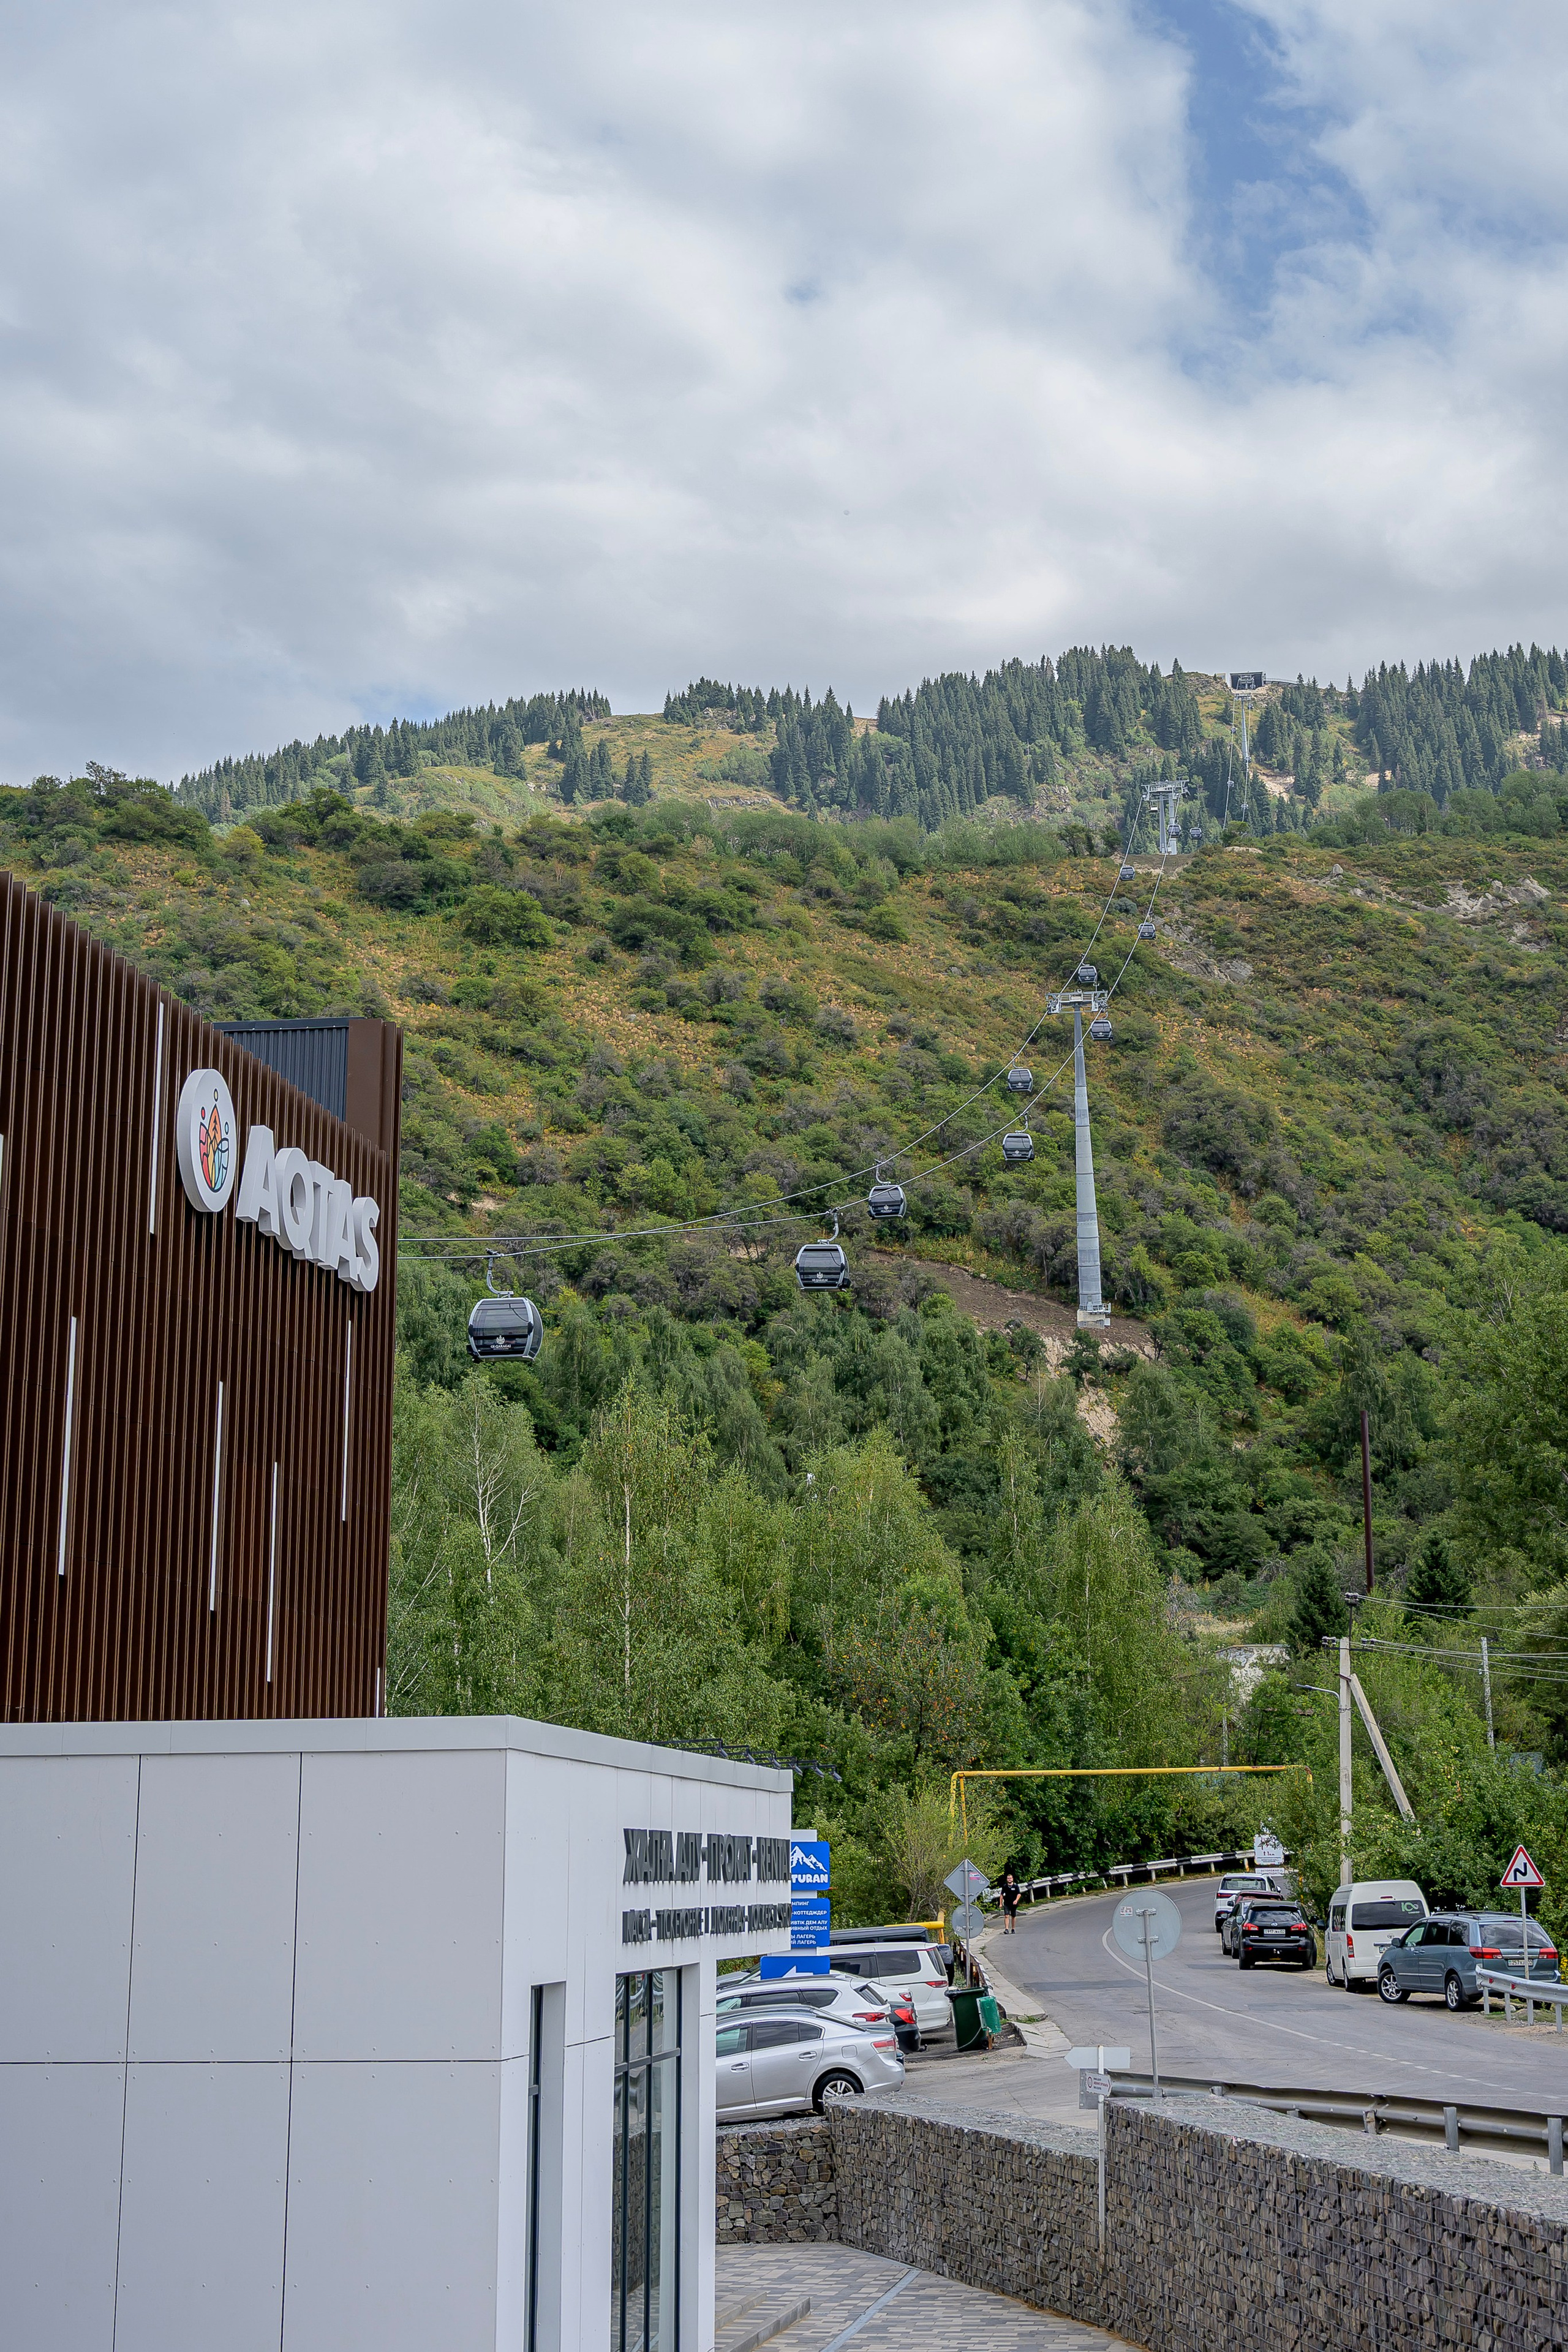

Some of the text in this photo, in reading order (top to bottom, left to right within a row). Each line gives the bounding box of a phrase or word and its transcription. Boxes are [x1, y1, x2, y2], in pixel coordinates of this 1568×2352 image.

[235, 1125, 380, 1292] AQTAS
[707, 1833, 753, 1882] ПРОКАТ
[622, 1909, 652, 1943] КАССА
[777, 1903, 792, 1929] SHO
